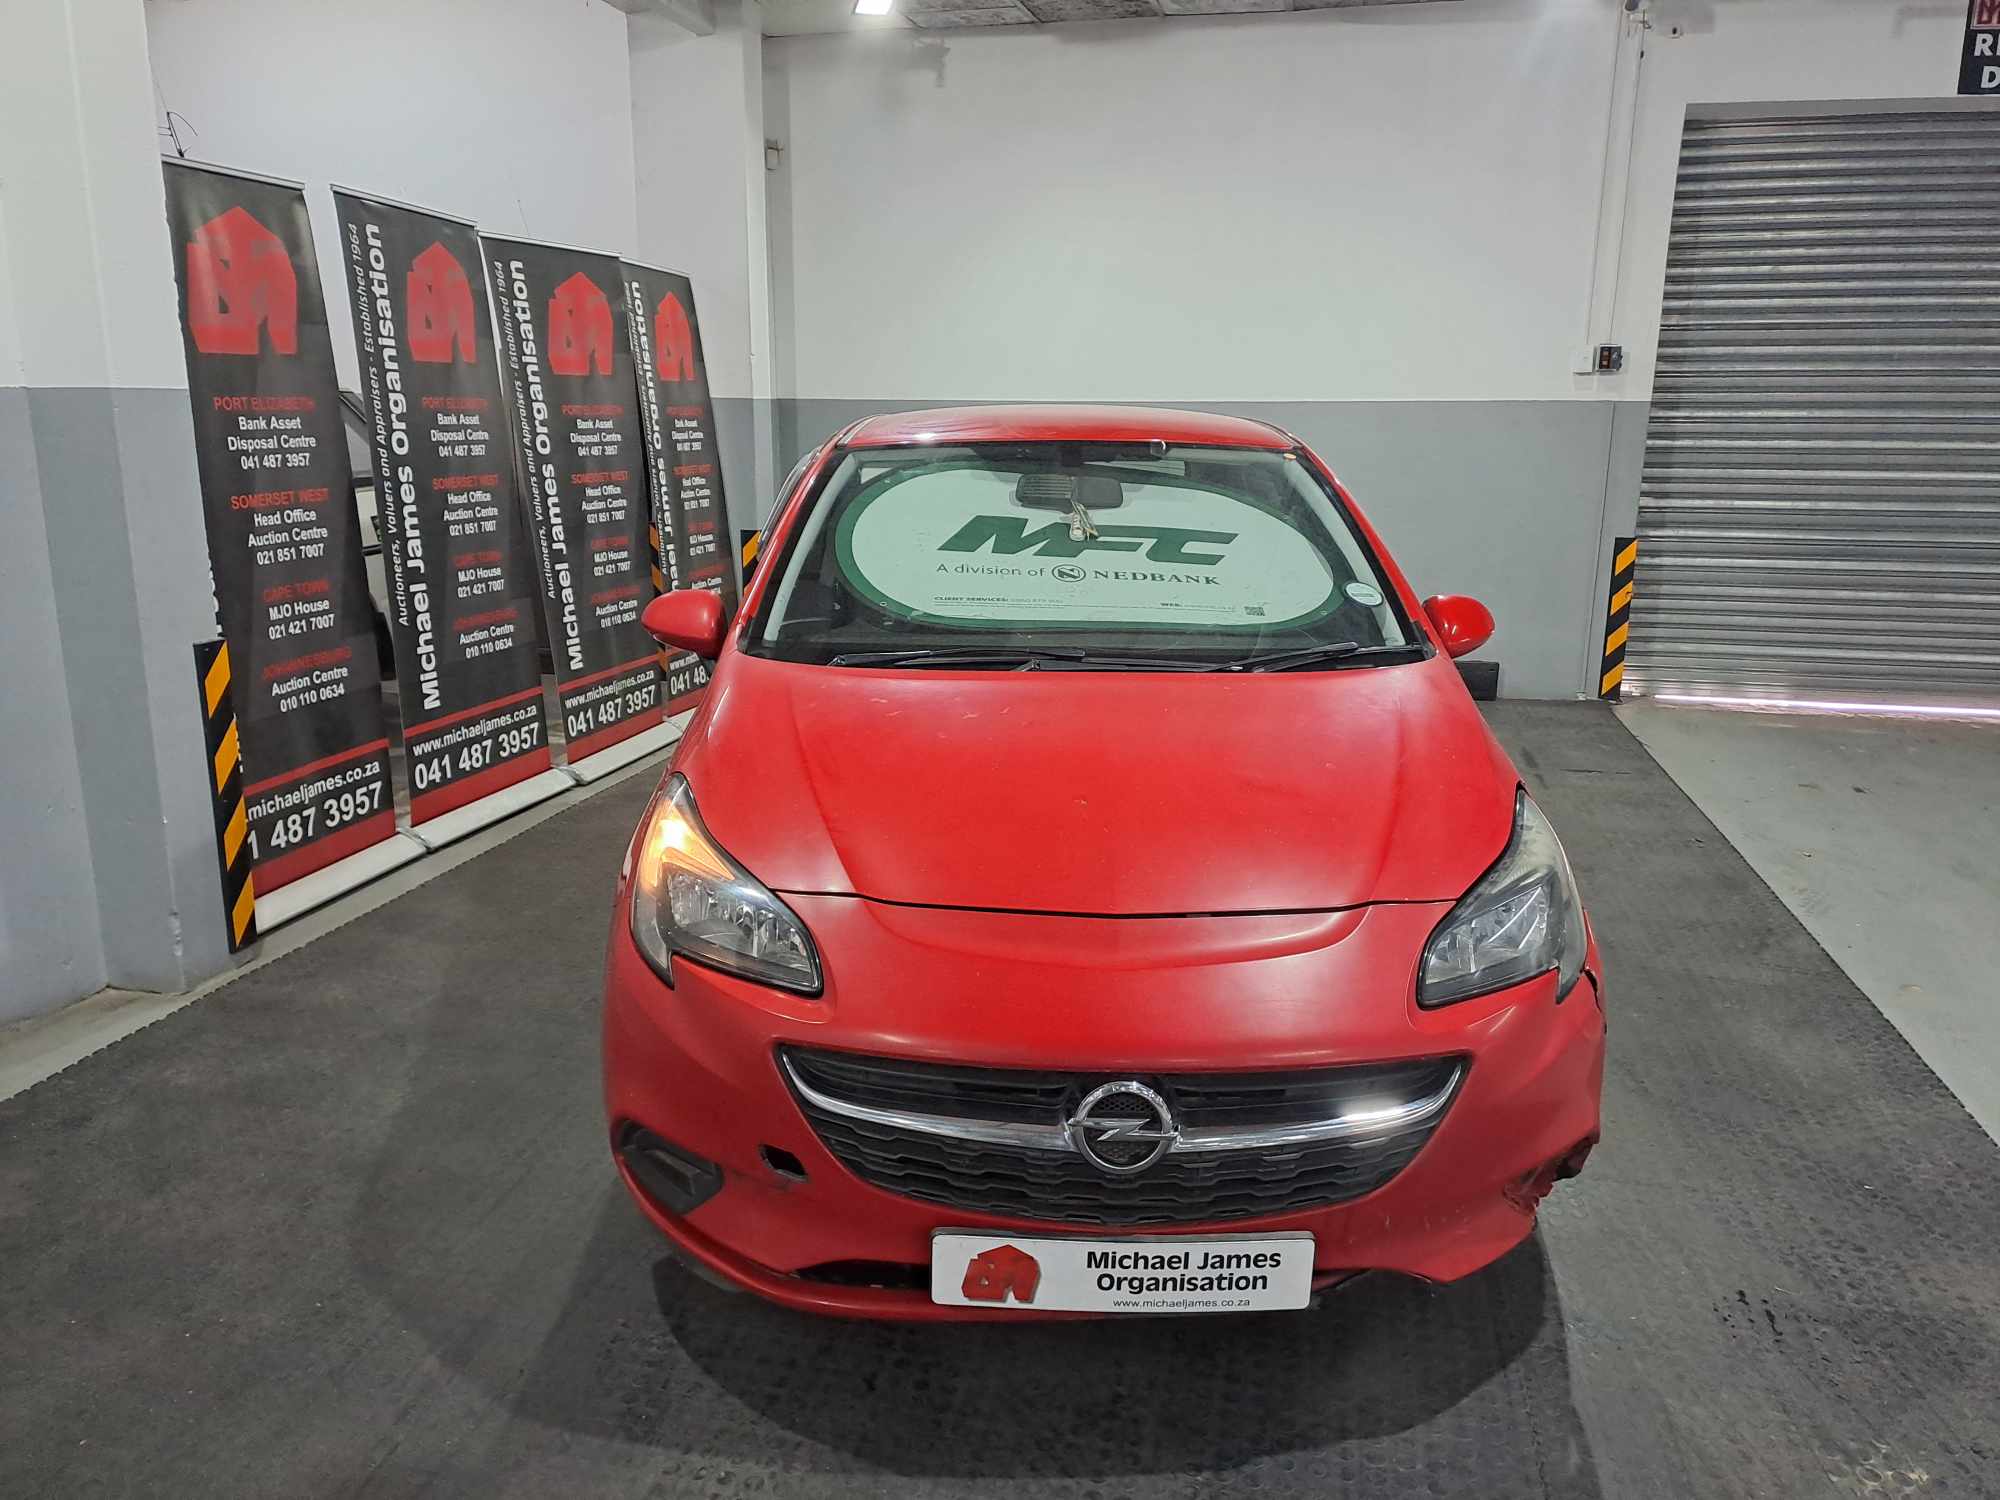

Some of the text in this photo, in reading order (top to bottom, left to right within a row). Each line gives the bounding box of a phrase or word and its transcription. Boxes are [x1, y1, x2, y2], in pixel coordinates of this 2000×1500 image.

[1974, 33, 2000, 56] R
[348, 223, 361, 261] 1964
[353, 265, 375, 353] Established
[631, 281, 661, 450] Organisation
[213, 396, 248, 410] PORT
[368, 367, 388, 446] Appraisers
[514, 380, 533, 447] Appraisers
[238, 416, 301, 430] Bank Asset
[437, 413, 457, 425] Bank
[227, 435, 317, 452] Disposal Centre
[430, 429, 465, 442] Disposal
[241, 453, 310, 470] 041 487 3957
[379, 447, 391, 477] and
[439, 445, 452, 457] 041
[366, 223, 441, 711] Michael James Organisation
[510, 260, 584, 672] Michael James Organisation
[231, 490, 294, 509] SOMERSET
[384, 480, 397, 535] Valuers
[447, 493, 468, 504] Head
[657, 458, 673, 537] James
[254, 509, 317, 527] Head Office
[444, 506, 498, 521] Auction Centre
[248, 527, 328, 547] Auction Centre
[449, 524, 462, 536] 021
[465, 522, 479, 534] 851
[256, 544, 325, 566] 021 851 7007
[391, 540, 409, 626] Auctioneers,
[936, 564, 949, 573] A
[954, 564, 1022, 576] division
[1027, 568, 1048, 576] of
[1094, 570, 1221, 585] NEDBANK
[269, 600, 330, 621] MJO House
[268, 614, 335, 640] 021 421 7007
[459, 629, 489, 645] Auction
[271, 666, 348, 696] Auction Centre
[564, 670, 655, 709] www.michaeljames.co.za
[671, 665, 709, 695] 041 48
[280, 683, 345, 712] 010 110 0634
[567, 685, 656, 737] 041 487 3957
[413, 704, 537, 757] www.michaeljames.co.za
[414, 722, 539, 789] 041 487 3957
[271, 806, 316, 848] 487
[323, 781, 382, 828] 3957
[1086, 1251, 1282, 1270] Michael James
[1096, 1272, 1268, 1295] Organisation
[1113, 1299, 1250, 1309] www.michaeljames.co.za
